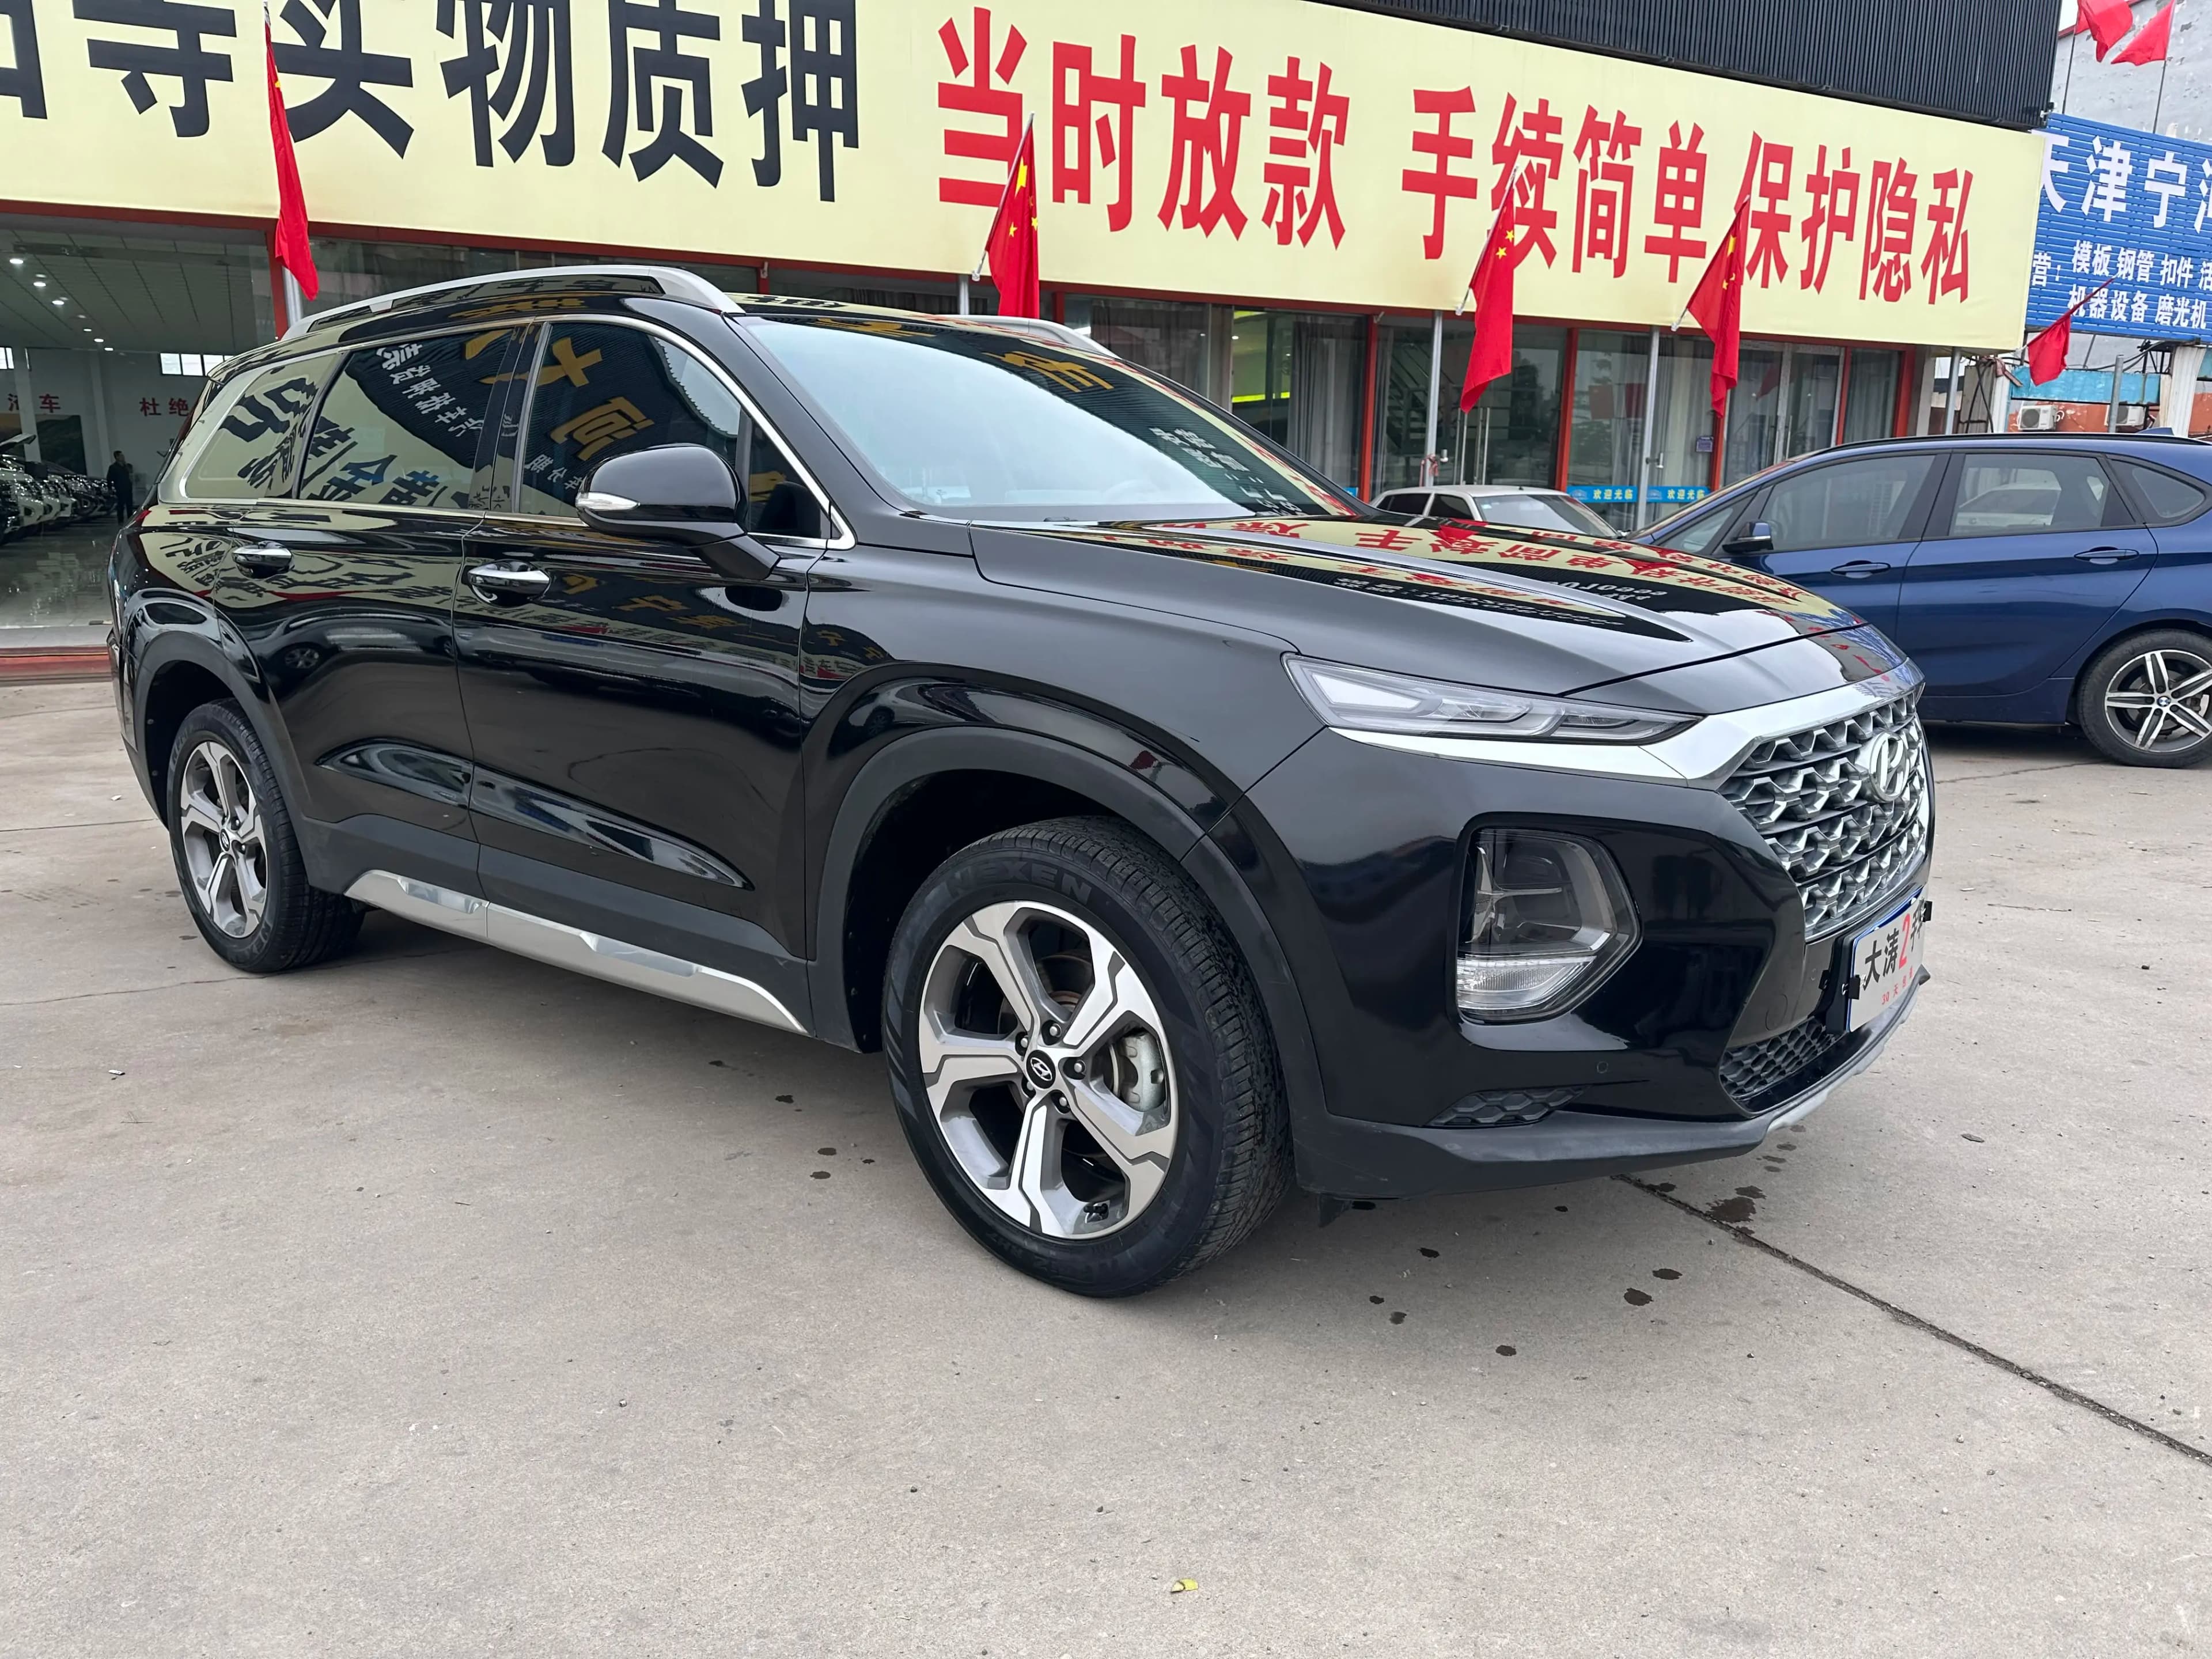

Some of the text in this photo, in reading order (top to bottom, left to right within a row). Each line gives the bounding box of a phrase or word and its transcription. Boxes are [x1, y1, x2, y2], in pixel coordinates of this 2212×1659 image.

[937, 6, 1350, 250] 当时放款
[1401, 85, 1709, 285] 手续简单
[1735, 131, 1974, 305] 保护隐私
[2071, 239, 2112, 277] 模板
[2116, 247, 2154, 283] 钢管
[2160, 254, 2194, 289] 扣件
[2067, 283, 2207, 329] 机器设备 磨光机
[139, 397, 190, 417] 杜绝
[1593, 488, 1633, 500] 欢迎光临
[1667, 488, 1706, 500] 欢迎光临
[946, 861, 1092, 905] NEXEN
